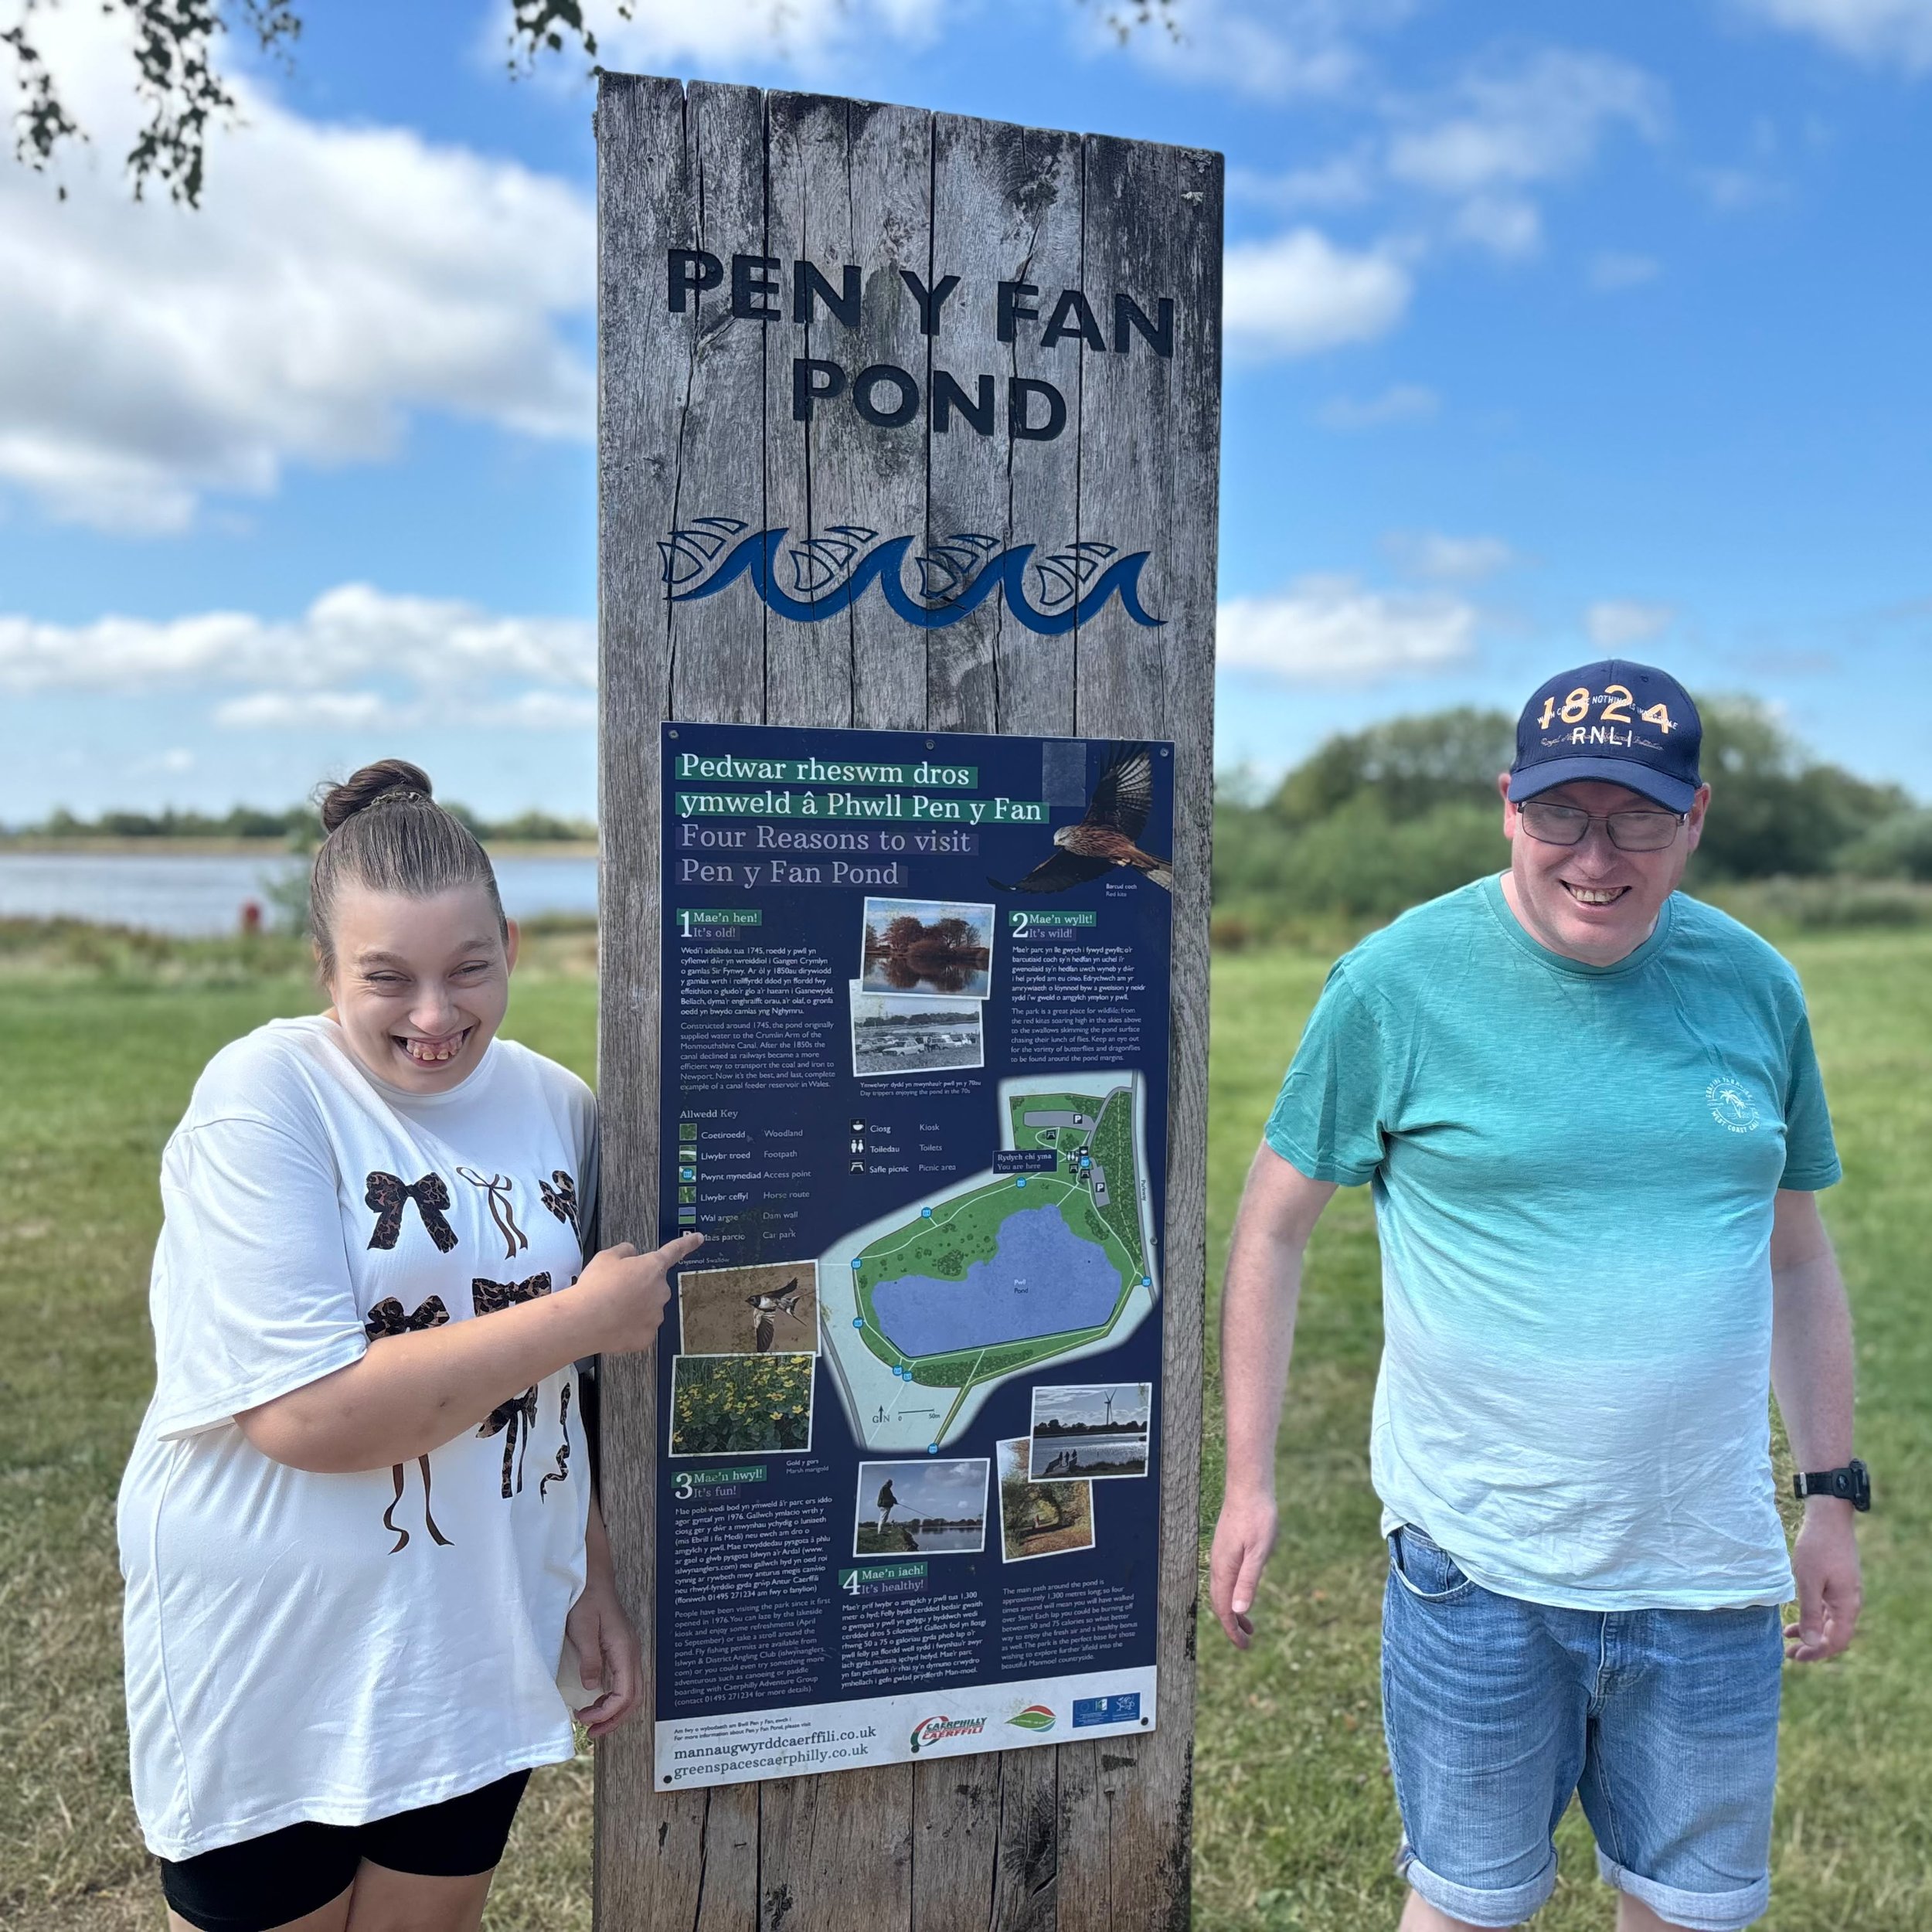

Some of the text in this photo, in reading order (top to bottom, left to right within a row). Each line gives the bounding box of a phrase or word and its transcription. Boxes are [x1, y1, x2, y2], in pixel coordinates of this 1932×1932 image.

[667, 248, 1175, 359] PEN Y FAN
[792, 357, 1067, 441] POND
[1540, 684, 1669, 734] 1824
[1572, 726, 1633, 747] RNLI
[682, 753, 968, 784] Pedwar rheswm dros
[681, 791, 1041, 825] ymweld â Phwll Pen y Fan
[682, 824, 971, 852] Four Reasons to visit
[682, 859, 898, 889] Pen y Fan Pond
[681, 910, 692, 937] 1
[693, 912, 757, 922] Mae'n hen!
[1029, 914, 1092, 926] Mae'n wyllt!
[694, 926, 735, 937] It's old!
[1012, 913, 1029, 937] 2
[1029, 928, 1071, 937] It's wild!
[804, 1021, 834, 1029] originally
[680, 1032, 709, 1041] supplied
[679, 1109, 737, 1118] Allwedd Key
[869, 1124, 890, 1133] Ciosg
[1727, 1124, 1747, 1133] COAST
[701, 1152, 726, 1161] Llwybr
[764, 1150, 797, 1158] Footpath
[791, 1170, 811, 1179] point
[888, 1165, 908, 1174] picnic
[701, 1172, 761, 1182] Pwynt mynediad
[700, 1192, 748, 1202] Llwybr ceffyl
[779, 1229, 795, 1240] park
[694, 1468, 762, 1483] Mae'n hwyl!
[675, 1473, 692, 1499] 3
[694, 1485, 736, 1498] It's fun!
[862, 1565, 923, 1580] Mae'n iach!
[842, 1570, 861, 1596] 4
[862, 1579, 923, 1594] It's healthy!
[1032, 1584, 1046, 1593] path
[1082, 1579, 1097, 1587] pond
[675, 1698, 702, 1706] (contact
[705, 1694, 726, 1702] 01495
[728, 1691, 753, 1699] 271234
[926, 1717, 988, 1731] CAERPHILLY
[922, 1727, 983, 1740] CAERFFILI
[674, 1726, 876, 1760] mannaugwyrddcaerffili.co.uk
[674, 1743, 869, 1780] greenspacescaerphilly.co.uk
